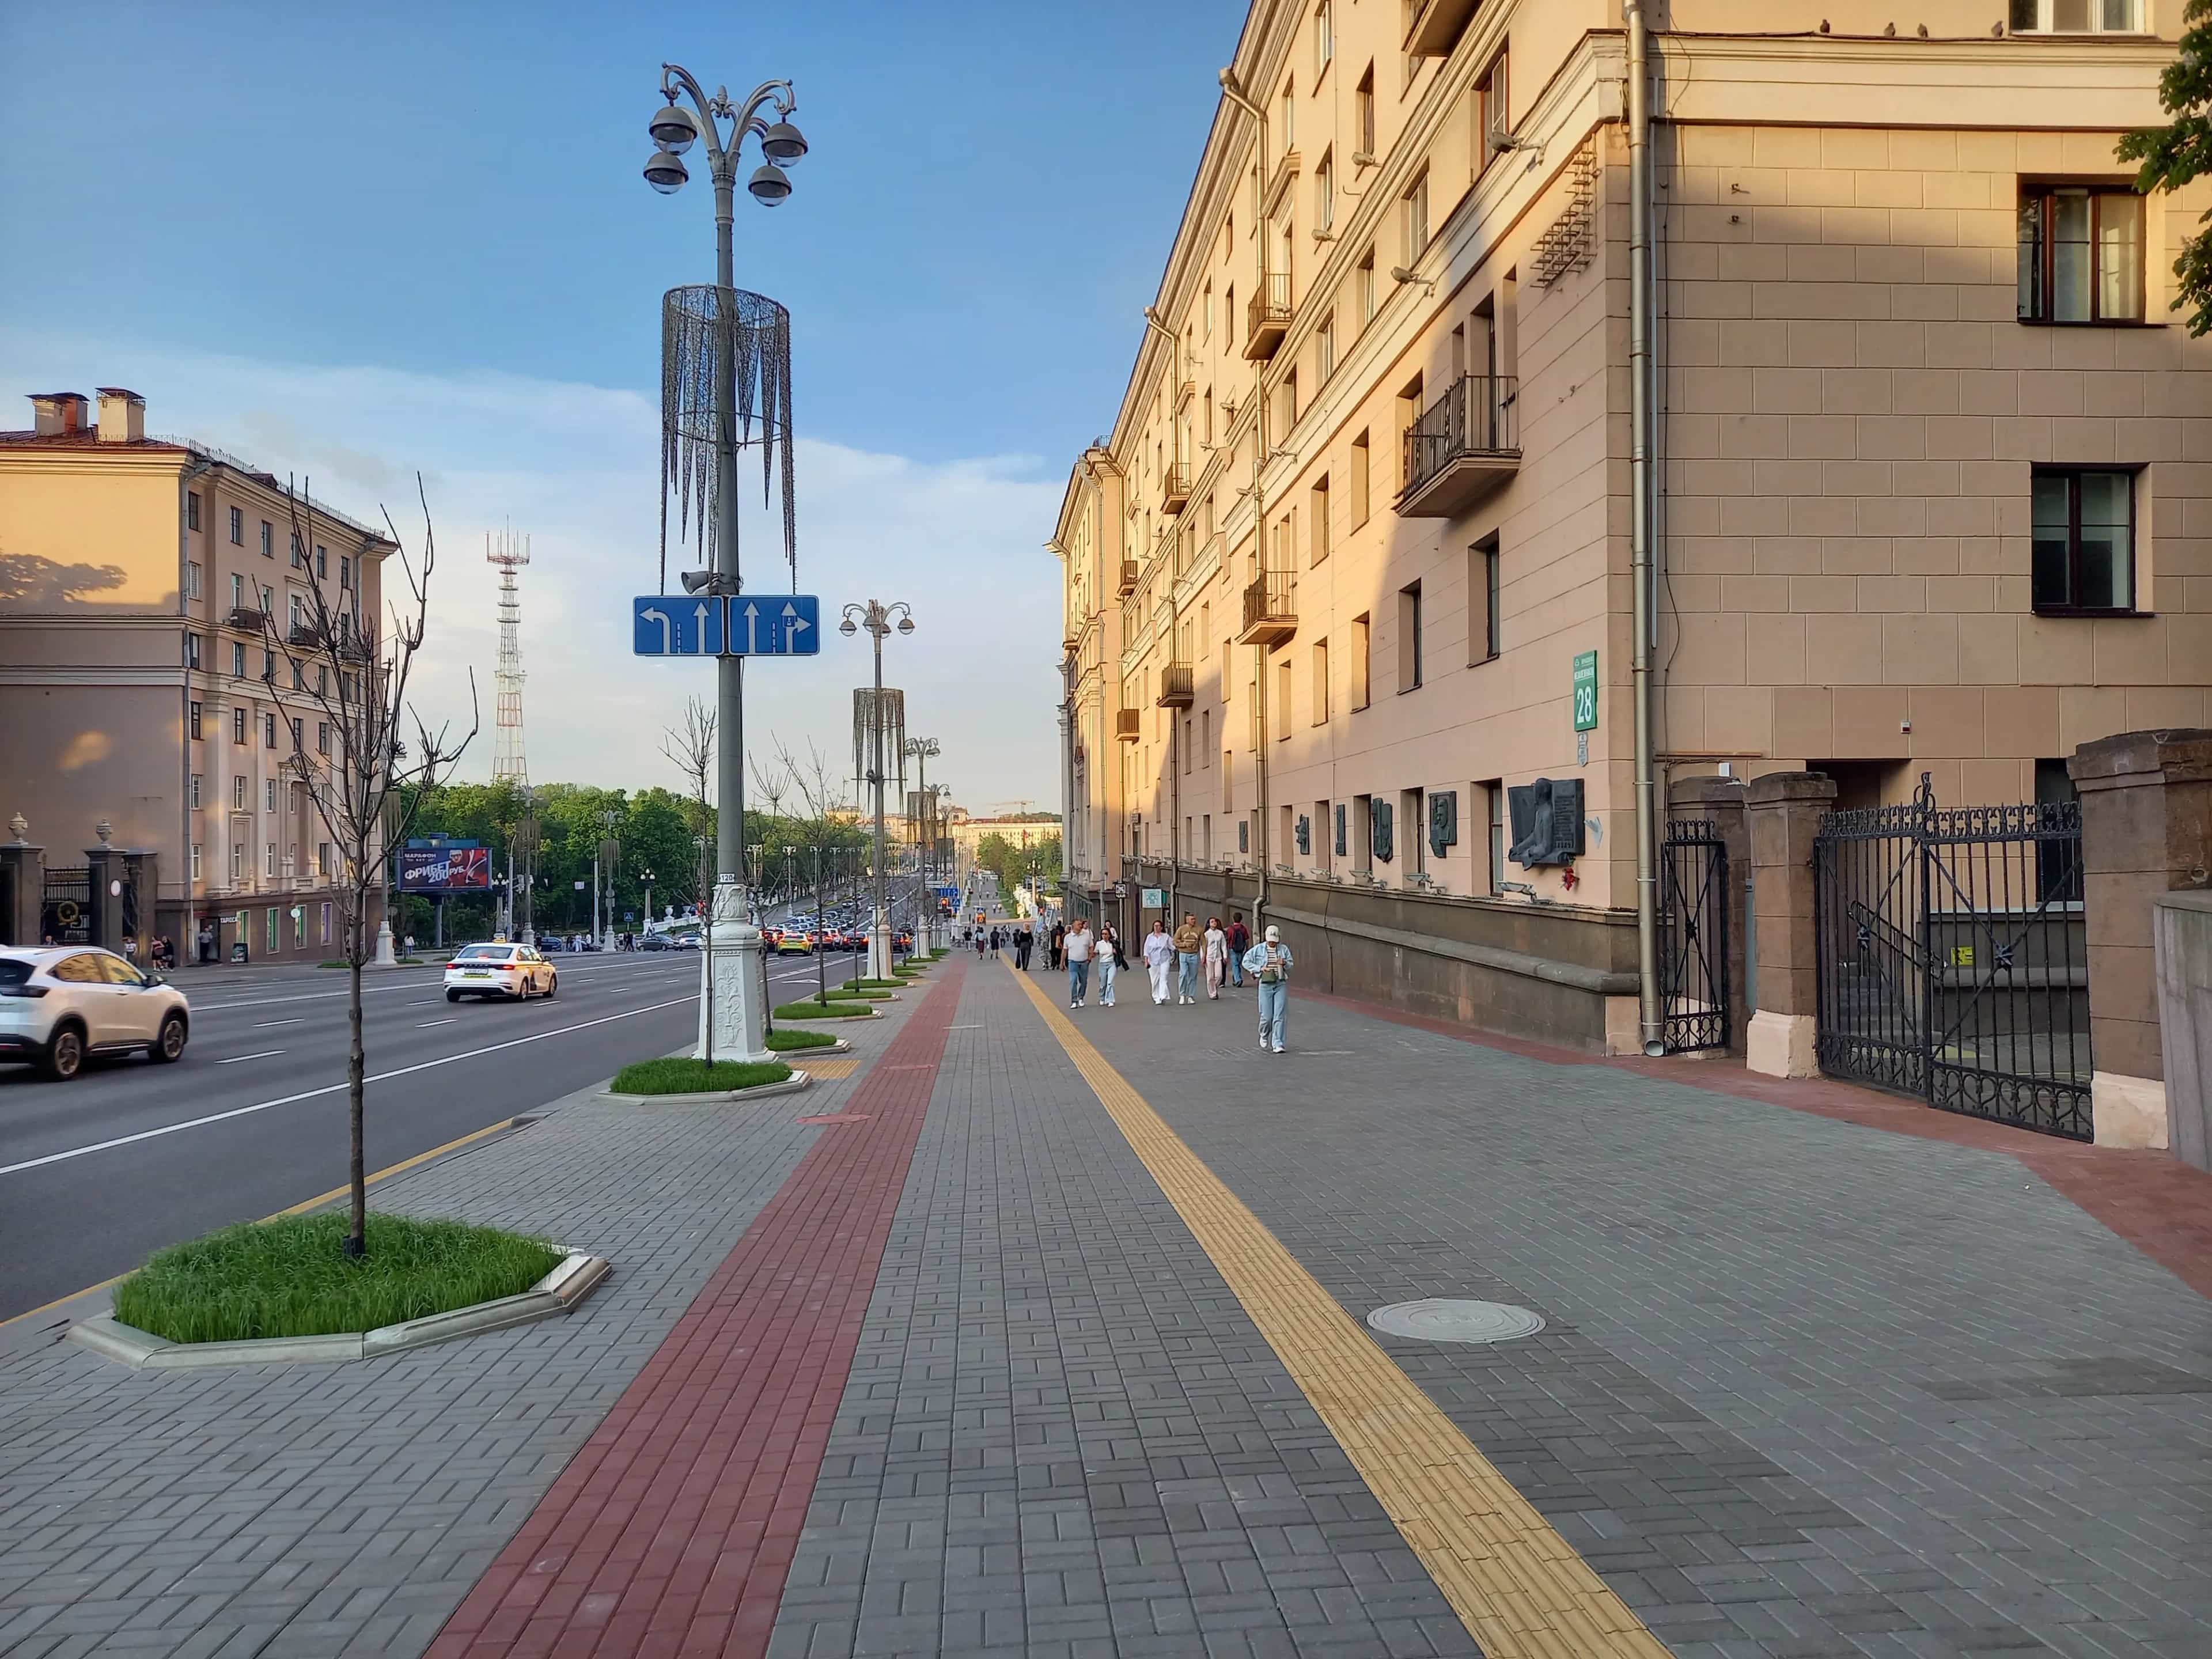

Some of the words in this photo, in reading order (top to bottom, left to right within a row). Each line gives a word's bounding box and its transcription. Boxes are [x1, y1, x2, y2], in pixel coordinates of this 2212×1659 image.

[1577, 686, 1592, 724] 28
[404, 860, 451, 880] ФРИБЕТ
[429, 870, 448, 883] 200
